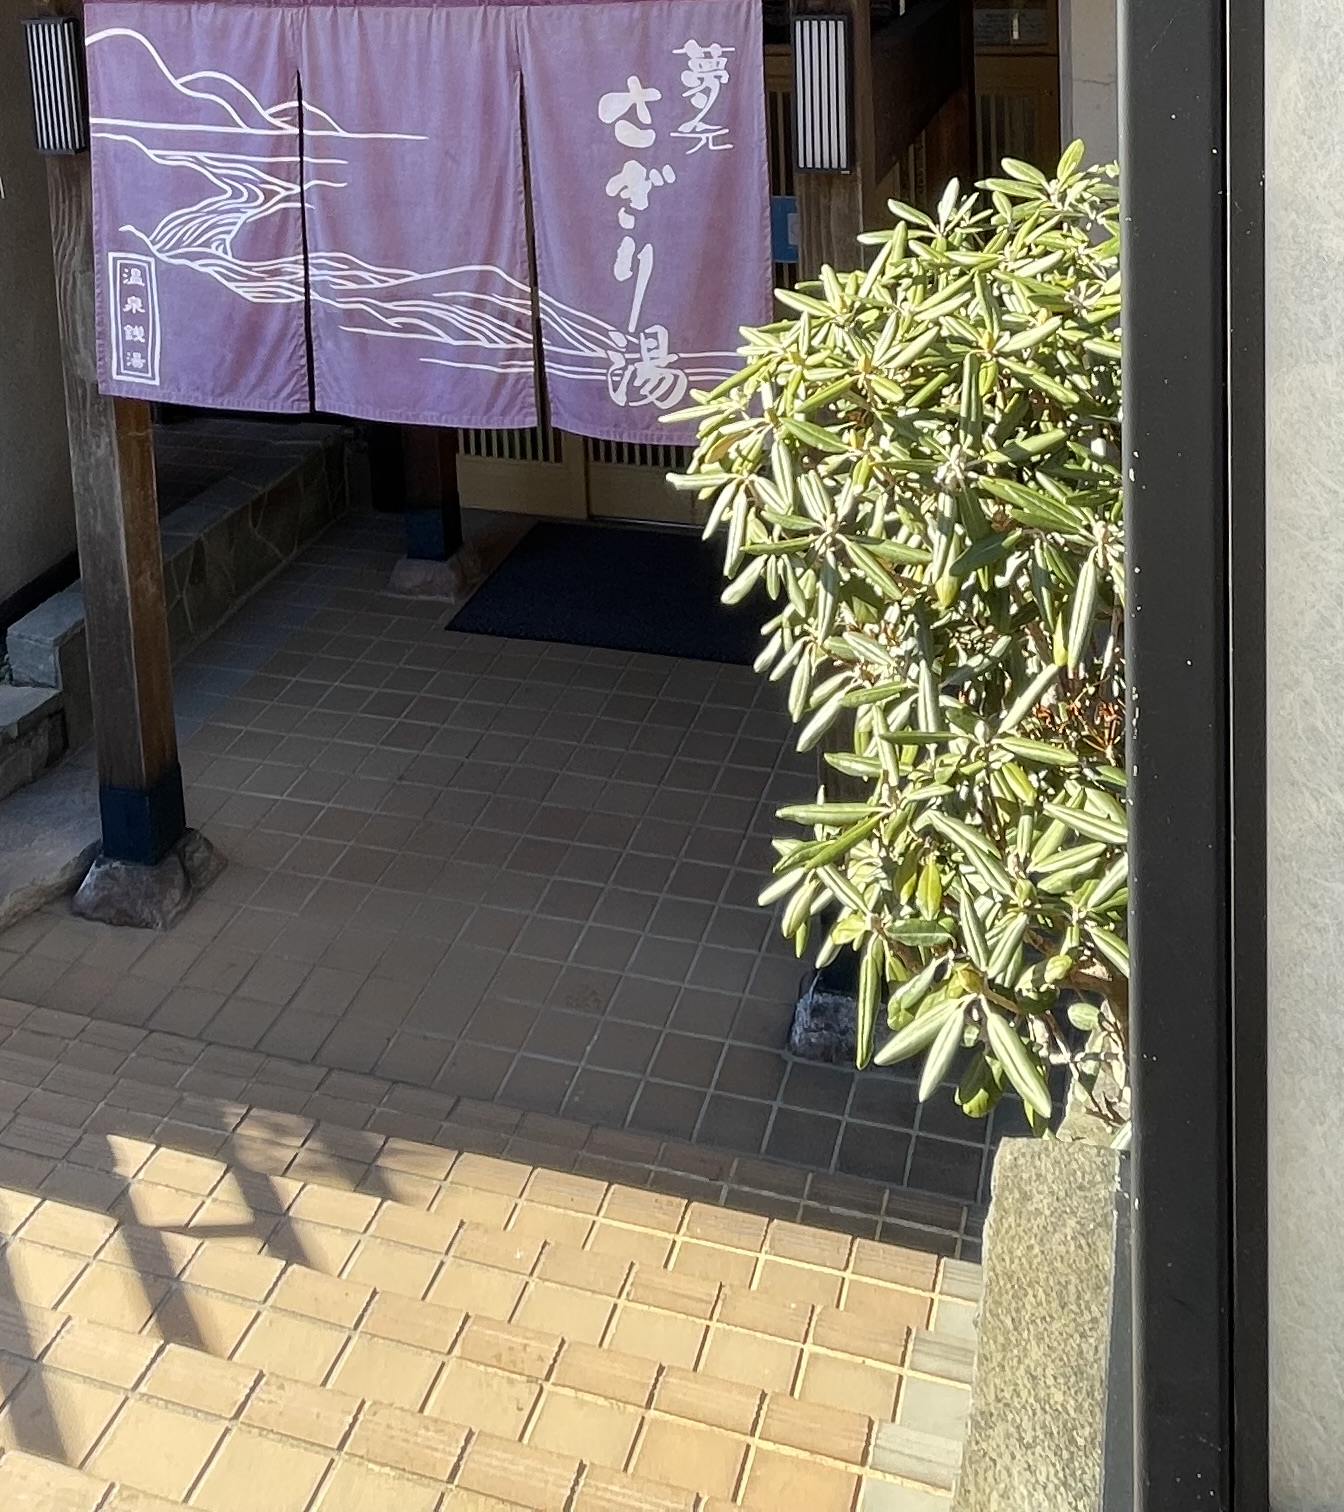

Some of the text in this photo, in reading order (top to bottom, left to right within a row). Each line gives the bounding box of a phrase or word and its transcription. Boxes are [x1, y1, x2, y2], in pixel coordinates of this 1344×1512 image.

[670, 39, 735, 155] 夢元
[598, 75, 688, 410] さぎり湯
